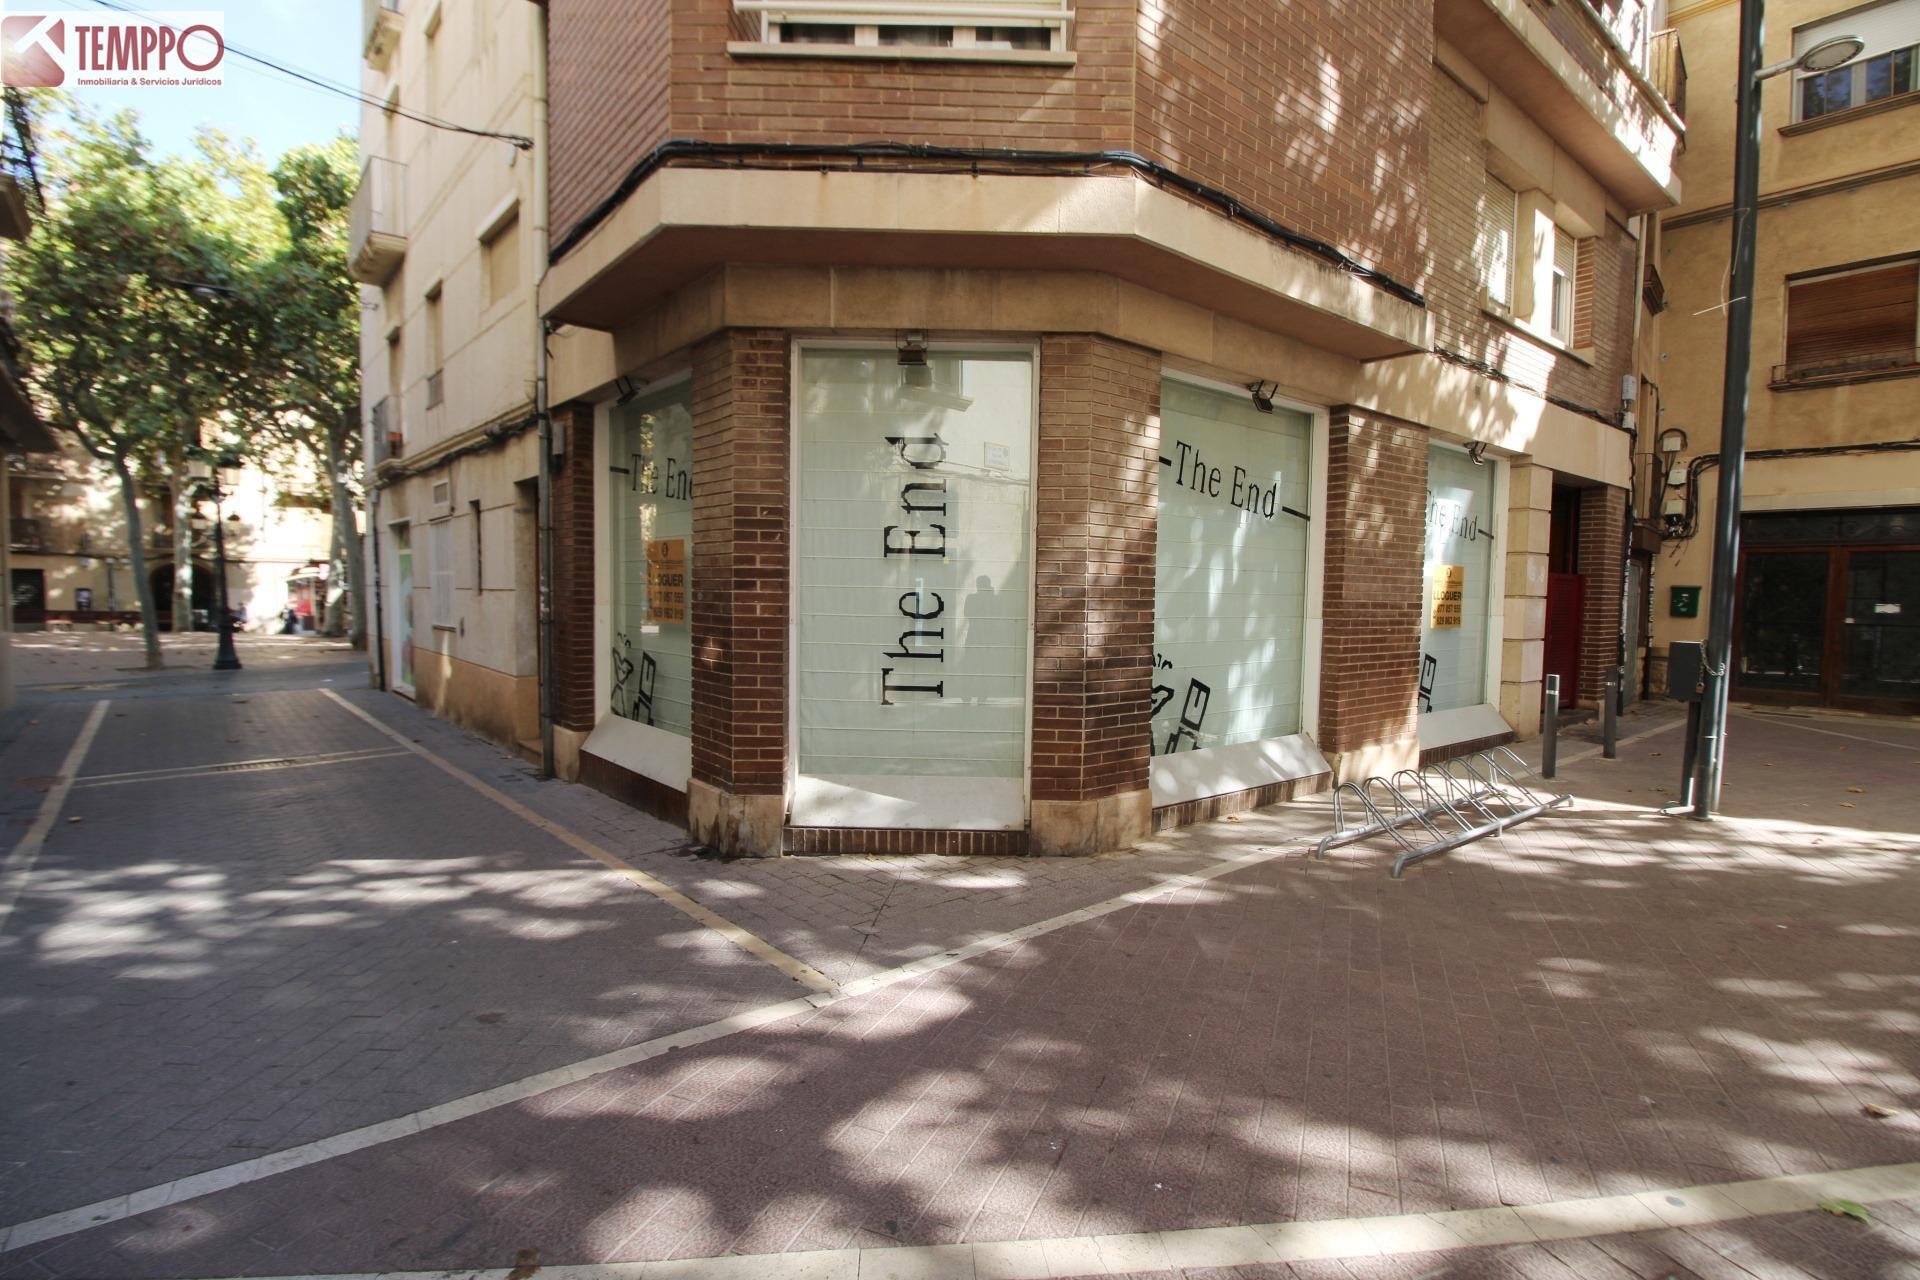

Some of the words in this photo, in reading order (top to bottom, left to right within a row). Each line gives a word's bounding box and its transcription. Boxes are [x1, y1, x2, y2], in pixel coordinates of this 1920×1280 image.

[884, 432, 950, 559] End
[1176, 440, 1222, 498] The
[1230, 465, 1277, 519] End
[1427, 489, 1446, 528] he
[881, 592, 945, 706] The
